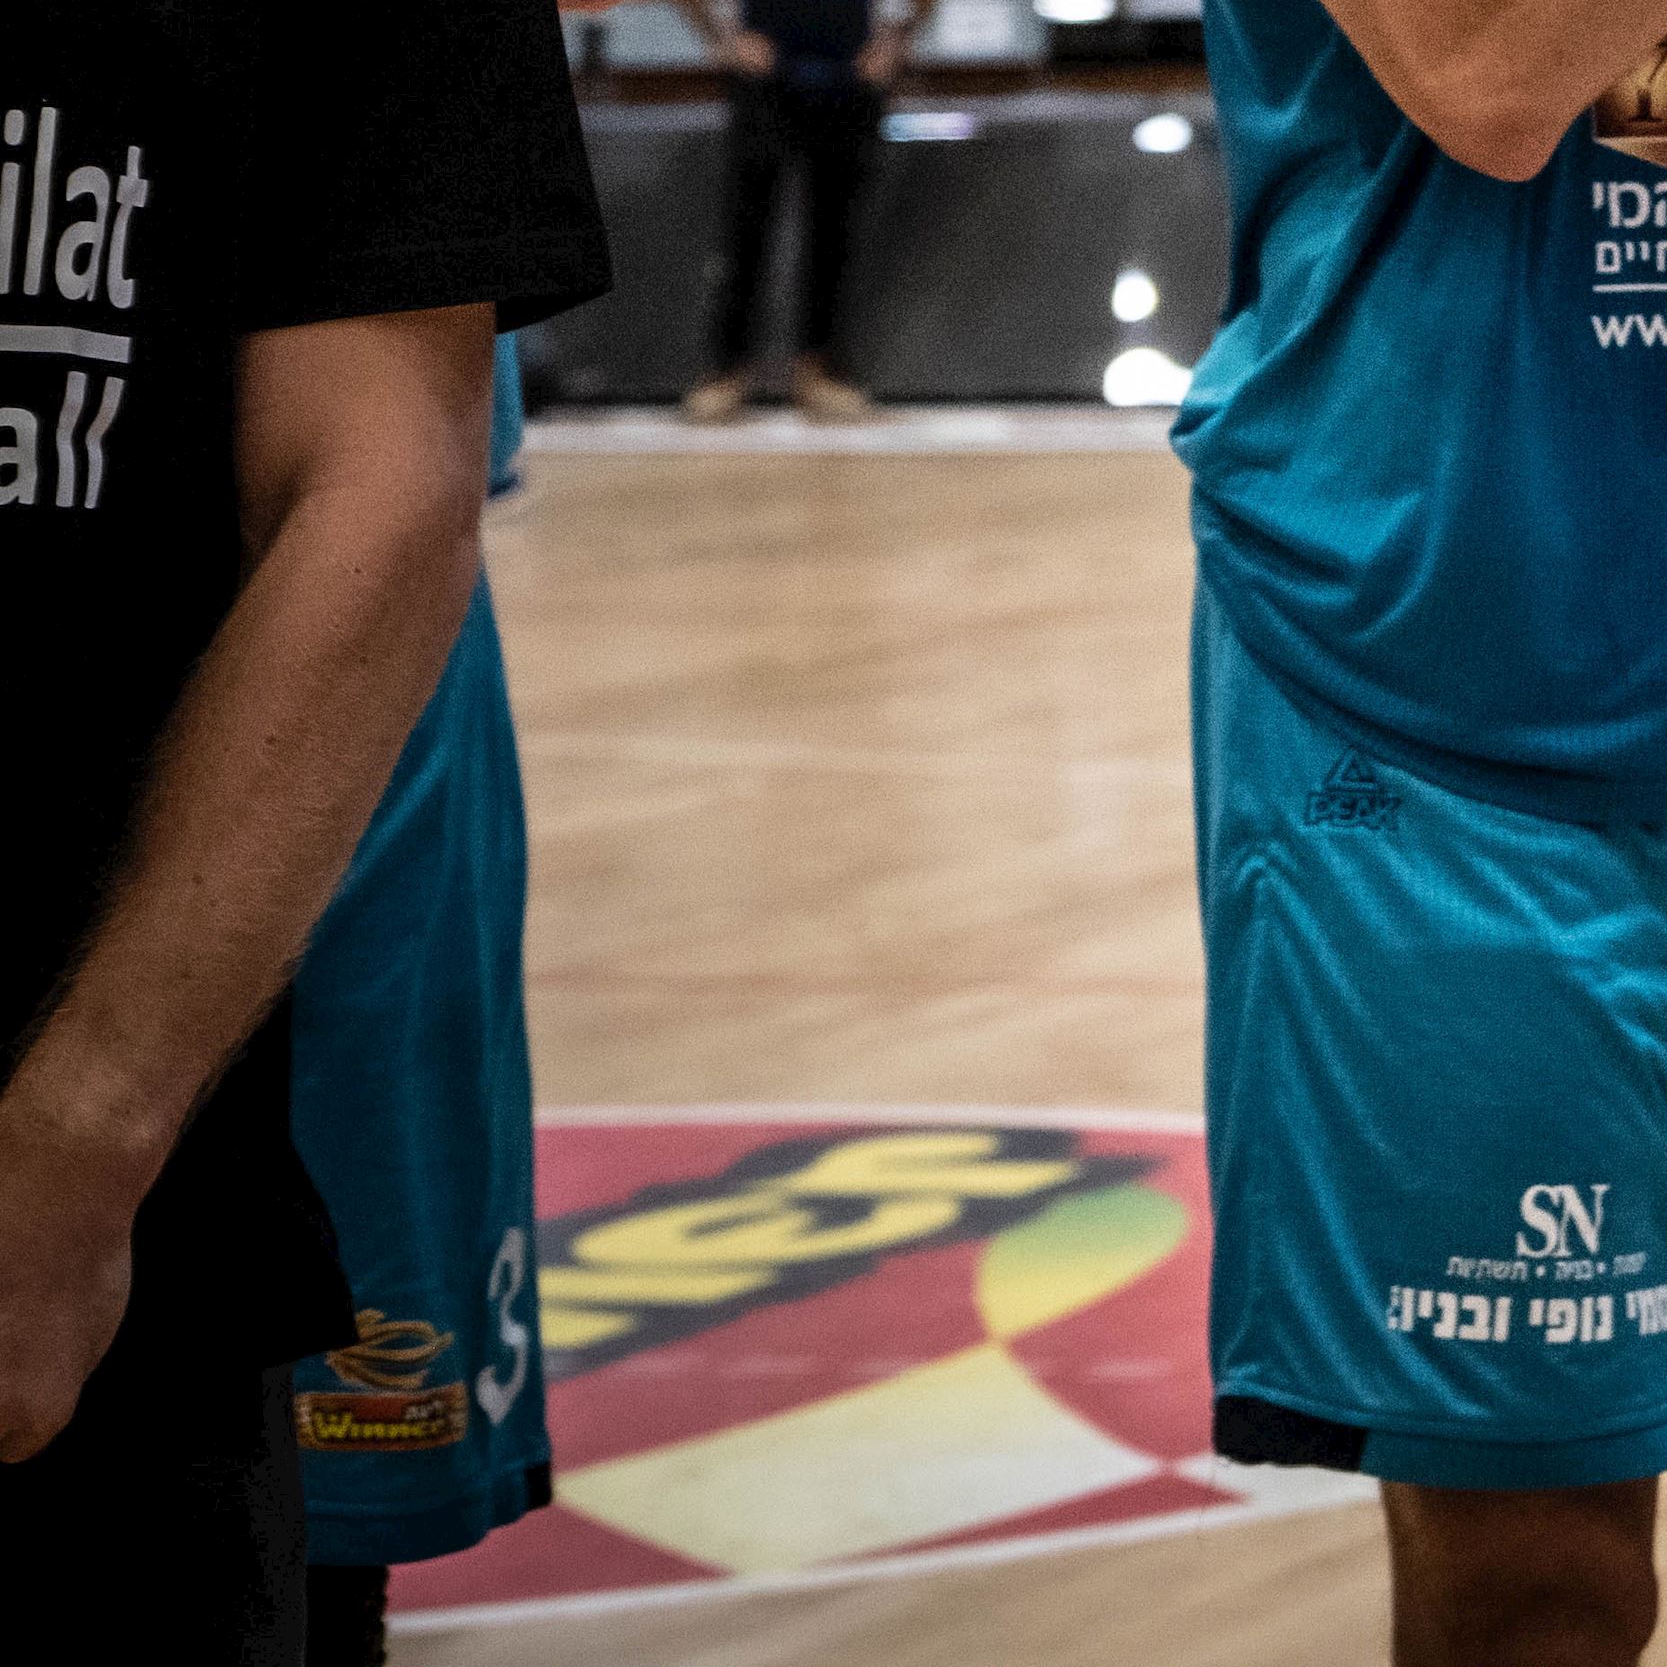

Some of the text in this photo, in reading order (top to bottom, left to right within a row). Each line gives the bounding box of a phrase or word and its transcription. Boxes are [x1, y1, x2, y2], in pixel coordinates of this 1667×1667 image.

[0, 105, 149, 309] ilat
[0, 370, 125, 510] all
[1516, 1183, 1611, 1259] SN
[1528, 1292, 1614, 1344] נופי
